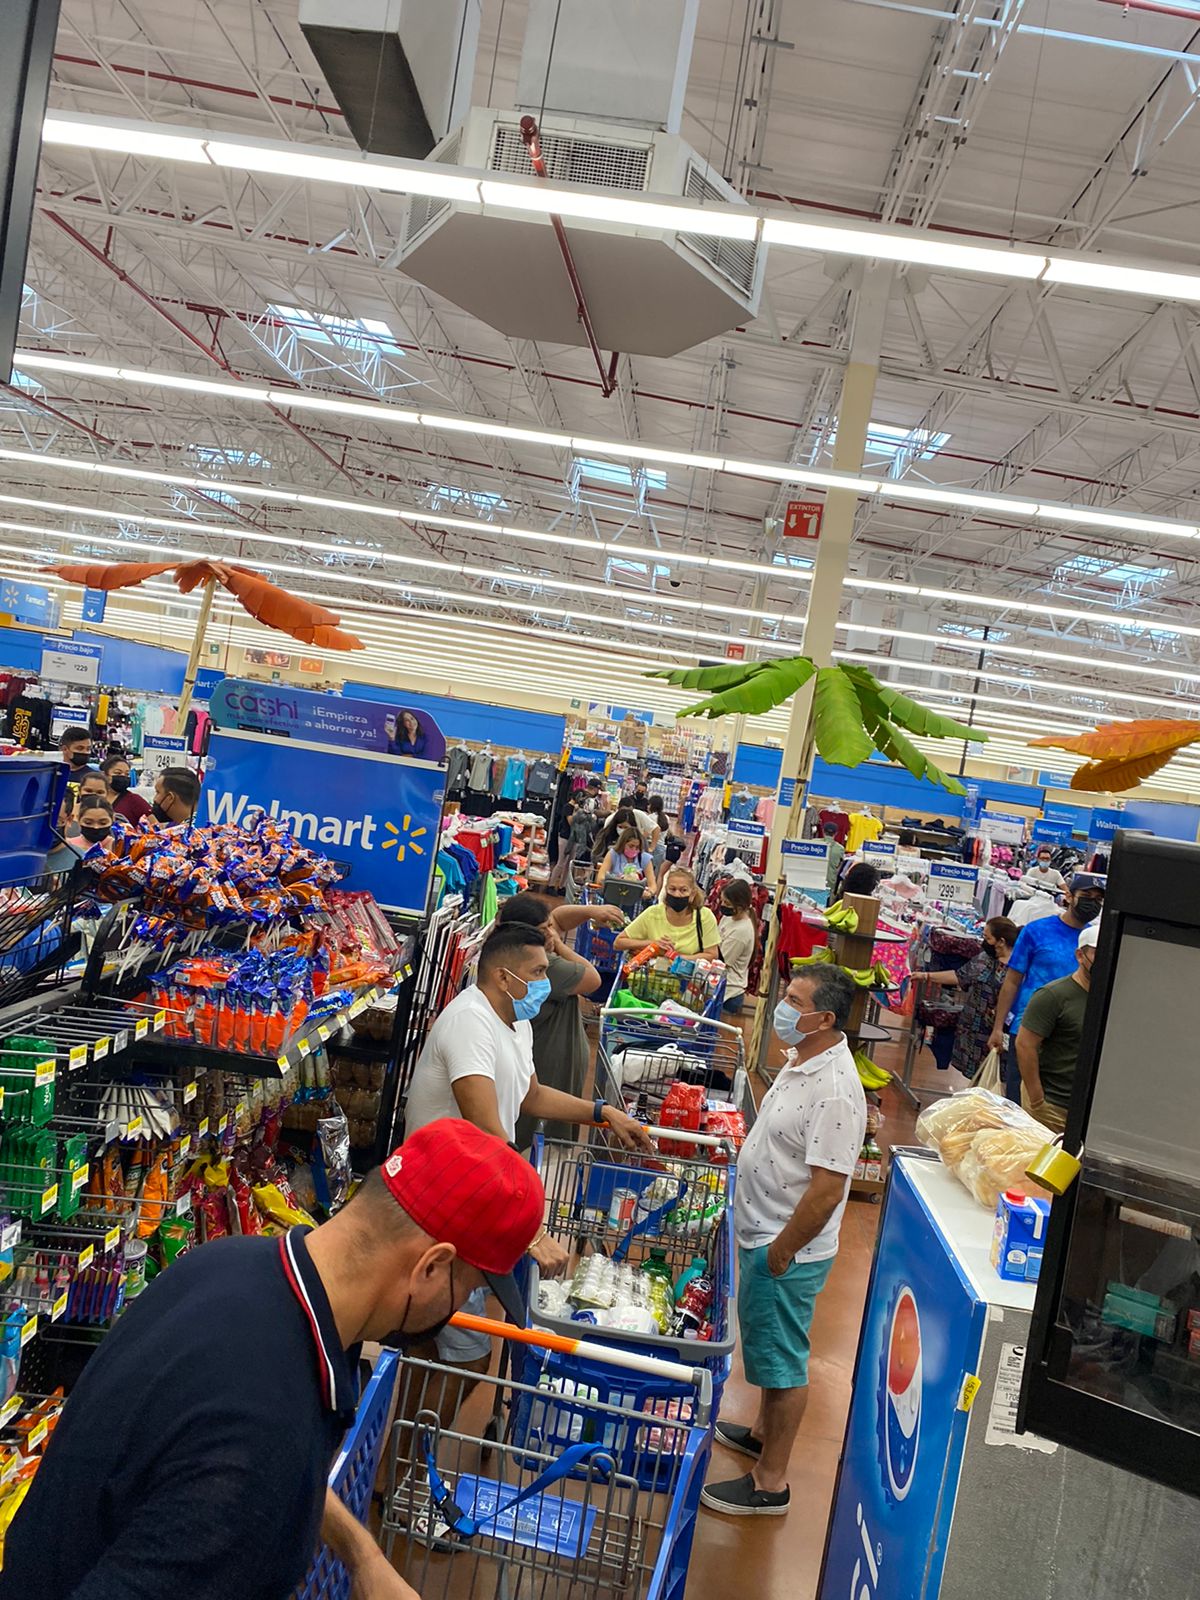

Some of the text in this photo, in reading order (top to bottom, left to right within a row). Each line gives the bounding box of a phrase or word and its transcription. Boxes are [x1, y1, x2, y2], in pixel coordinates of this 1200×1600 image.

[789, 503, 821, 513] EXTINTOR
[57, 642, 94, 655] Precio bajo
[58, 710, 75, 718] Precio
[312, 705, 368, 725] ¡Empieza
[304, 719, 378, 738] a ahorrar ya!
[152, 738, 183, 749] Precio bajo
[572, 754, 595, 763] Walmart
[207, 789, 377, 850] Walmart
[735, 821, 762, 833] Precio bajo
[1037, 827, 1062, 837] Walmart
[790, 843, 824, 855] Precio bajo
[940, 866, 975, 878] Precio bajo
